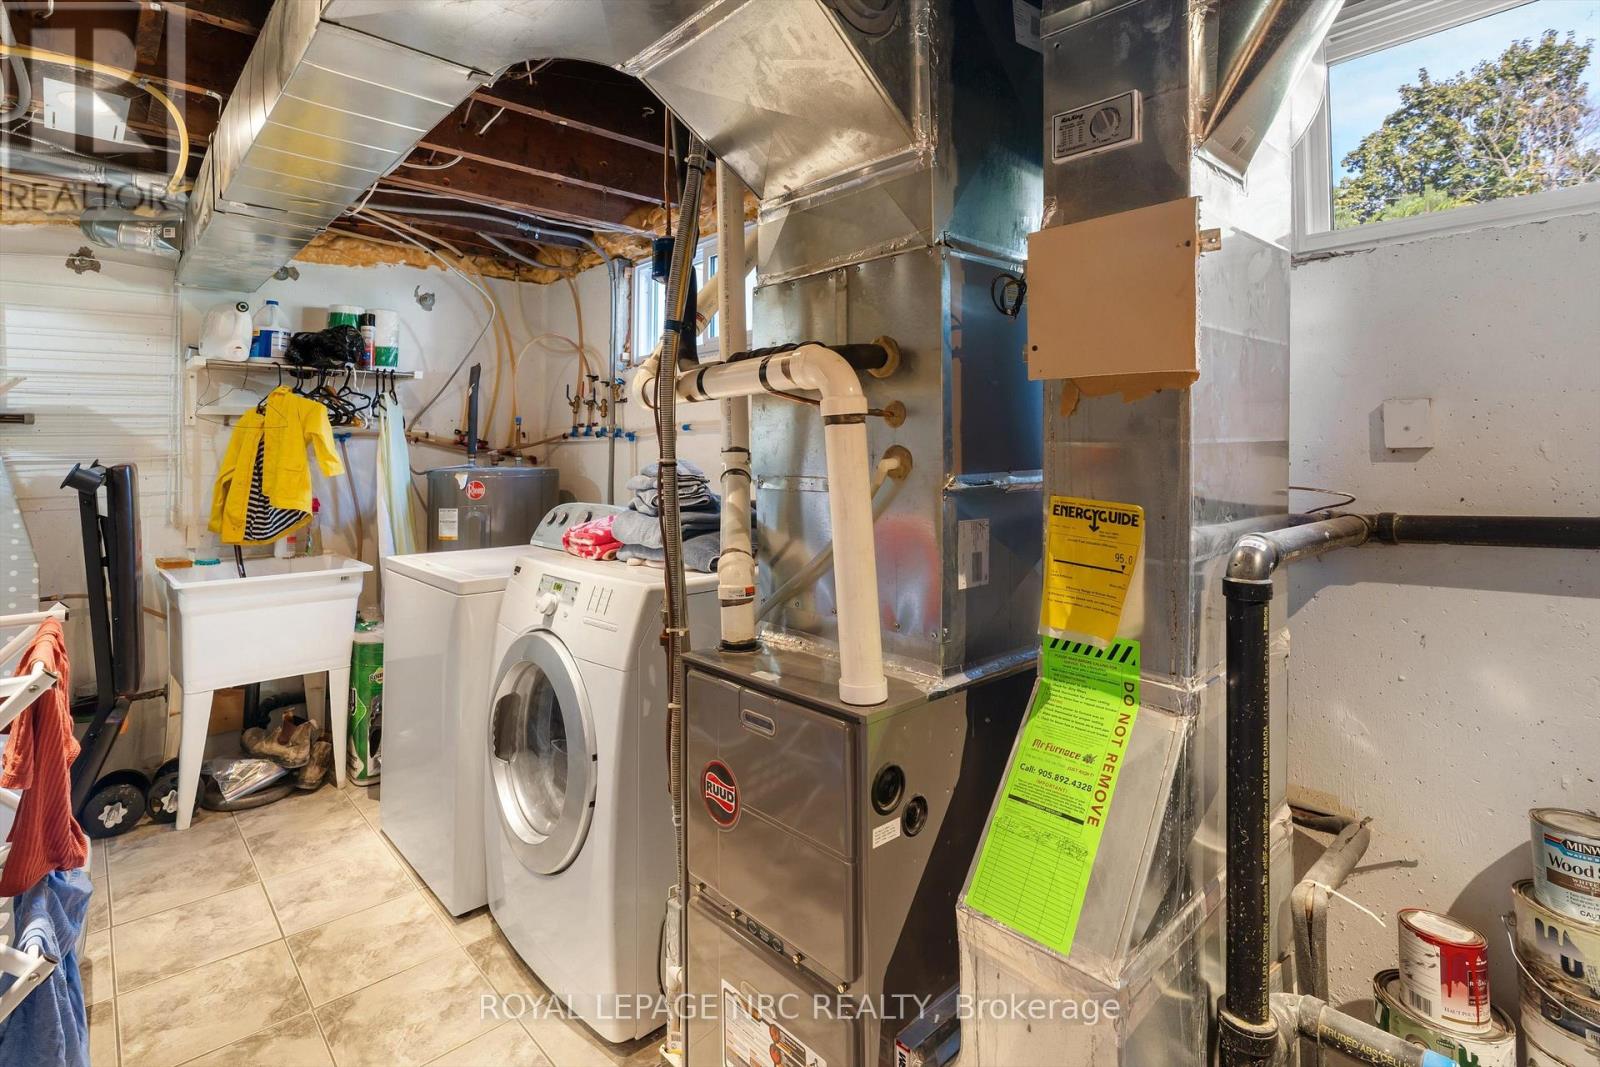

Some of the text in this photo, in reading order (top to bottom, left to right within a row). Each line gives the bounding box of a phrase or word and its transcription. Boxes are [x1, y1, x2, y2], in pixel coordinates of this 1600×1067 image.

[1053, 504, 1139, 527] ENERGYGUIDE
[1115, 552, 1133, 565] 95.0
[1045, 742, 1081, 760] Furnace
[1087, 681, 1135, 827] DO NOT REMOVE
[1020, 763, 1093, 792] Call: 905.892.4328
[706, 781, 735, 804] RUUD
[1548, 852, 1595, 879] Wood
